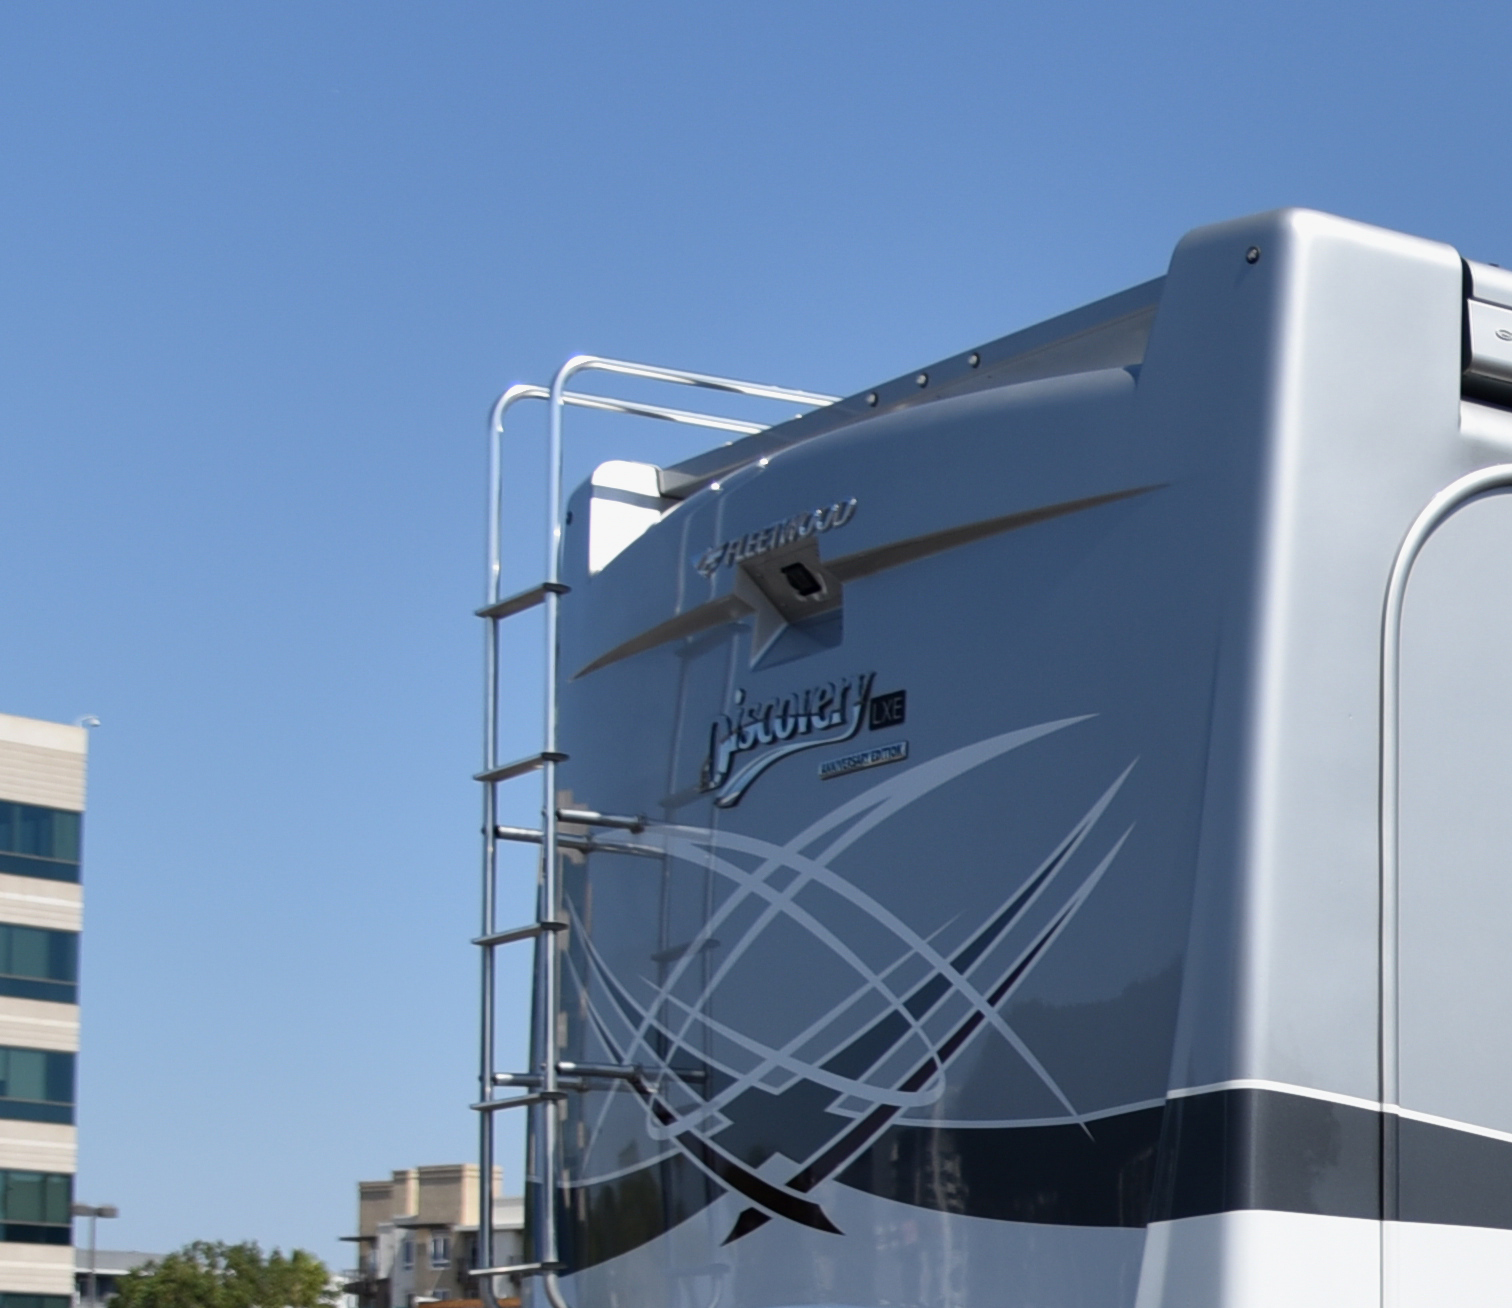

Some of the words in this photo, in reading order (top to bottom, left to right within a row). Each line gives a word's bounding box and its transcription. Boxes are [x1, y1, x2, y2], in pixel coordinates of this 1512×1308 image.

[721, 498, 859, 568] FLEETWOOD
[699, 672, 876, 797] Discovery
[870, 694, 906, 728] LXE
